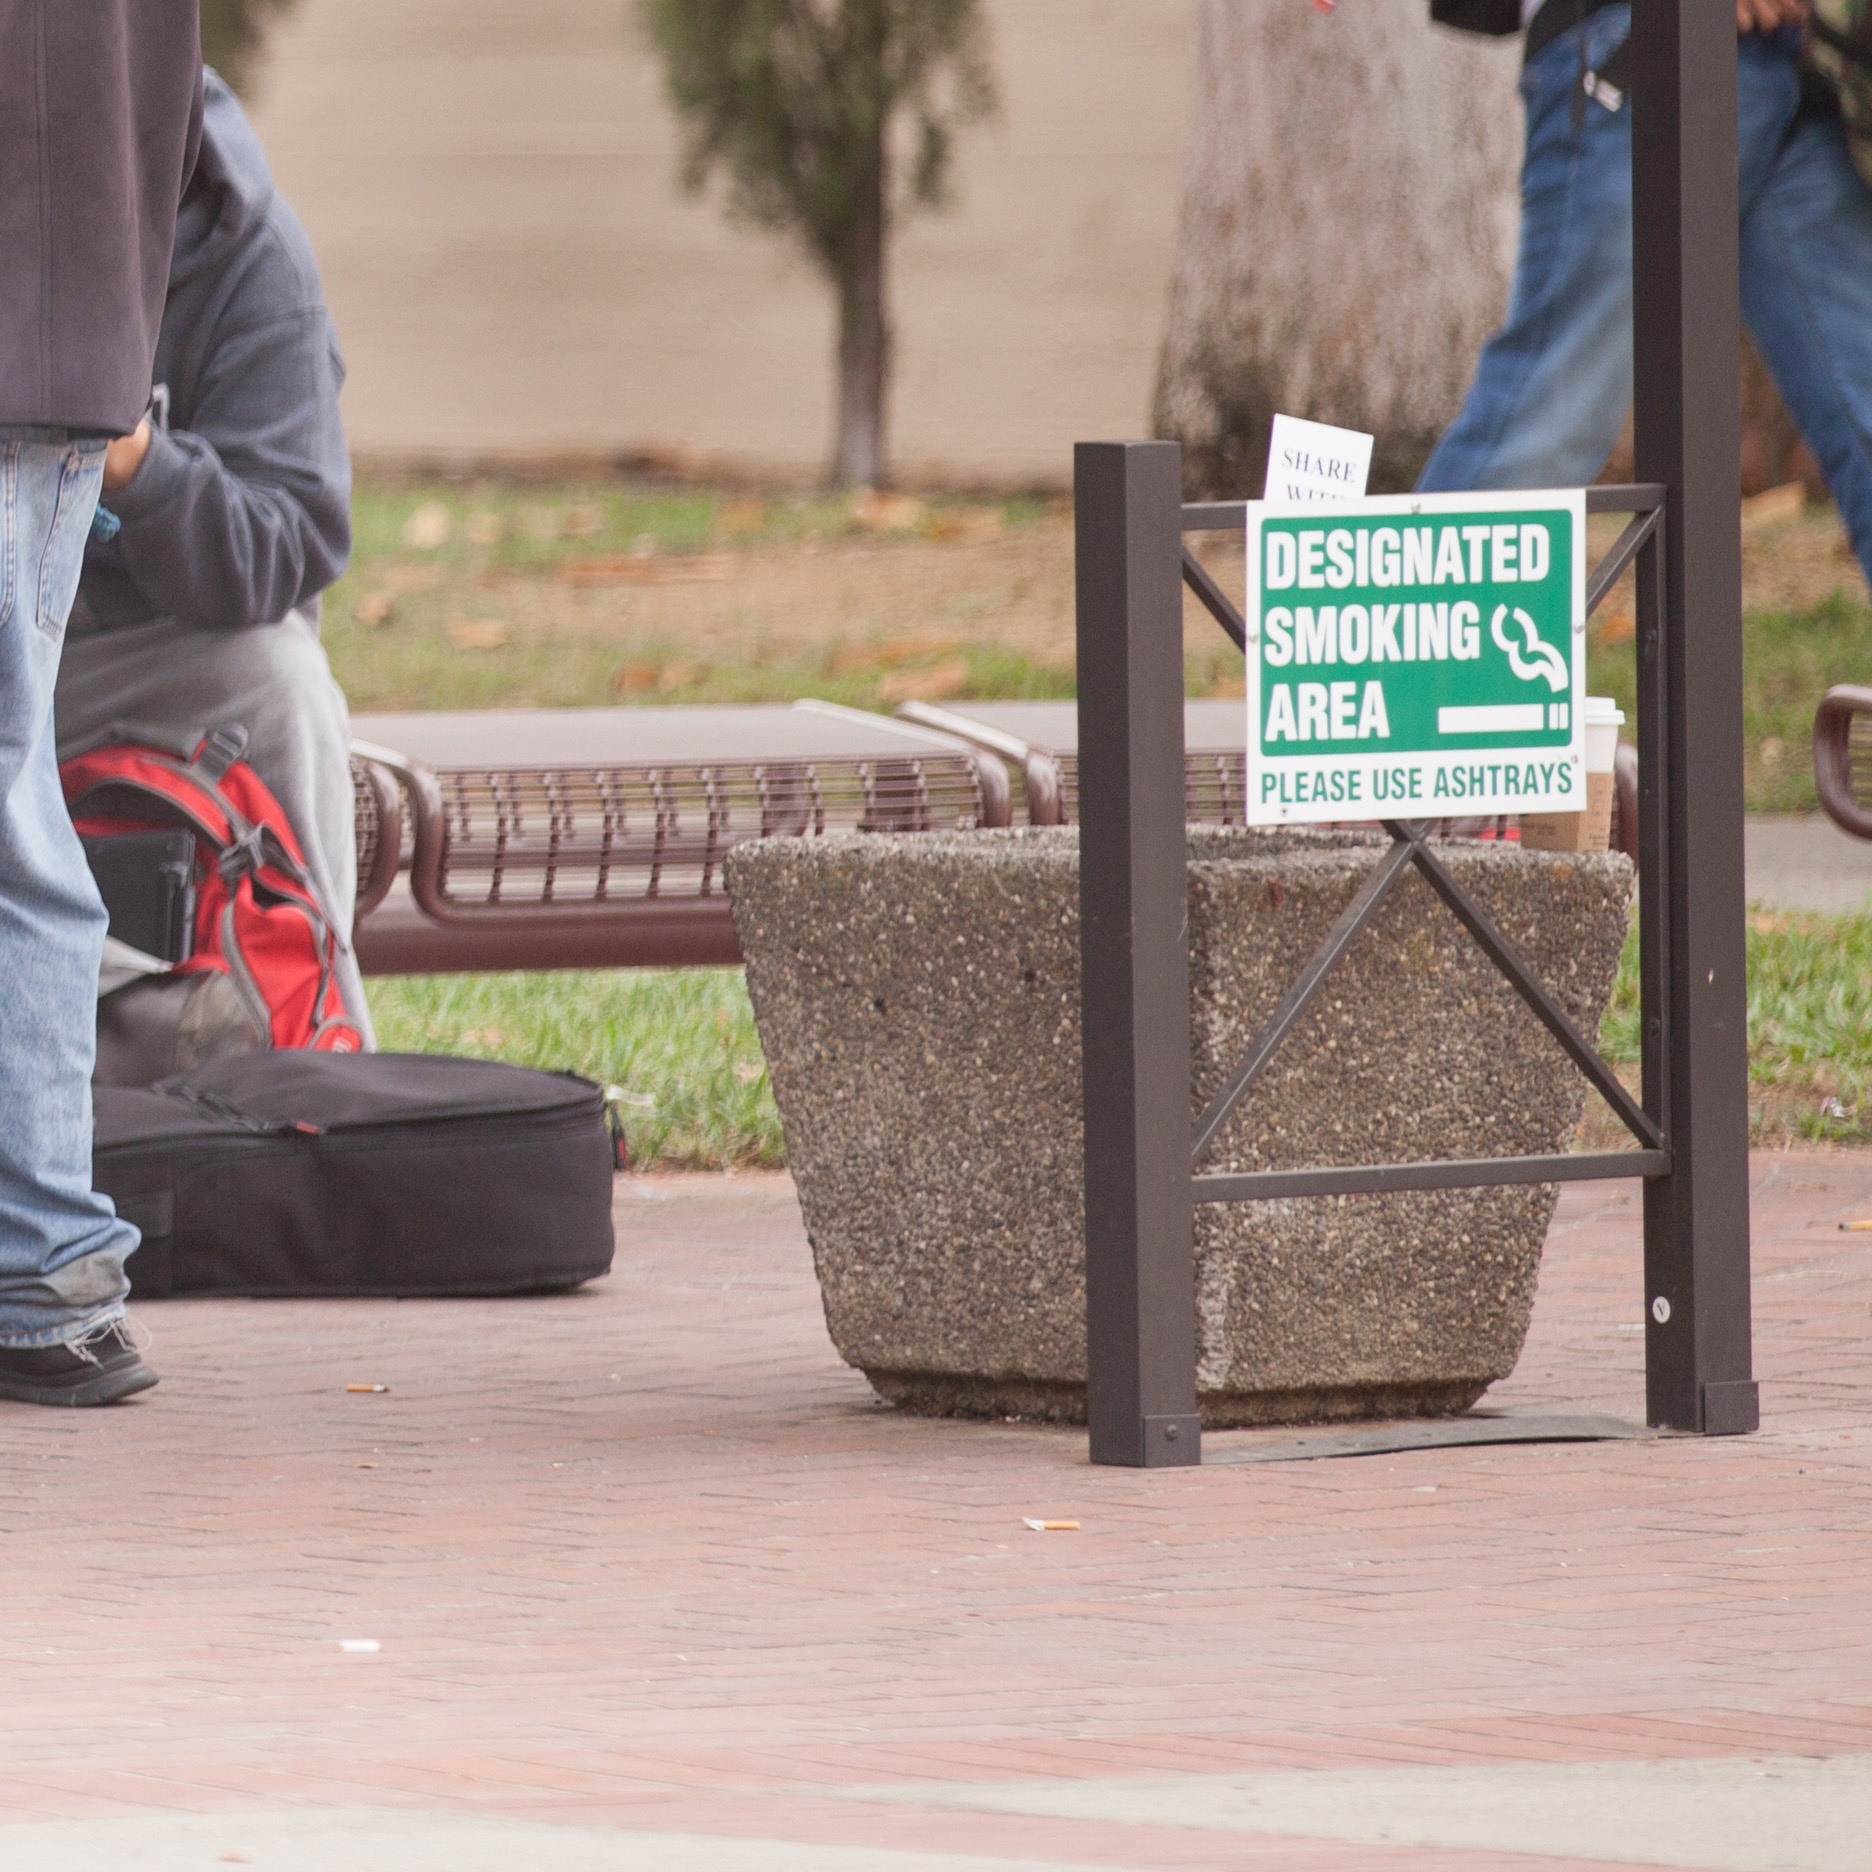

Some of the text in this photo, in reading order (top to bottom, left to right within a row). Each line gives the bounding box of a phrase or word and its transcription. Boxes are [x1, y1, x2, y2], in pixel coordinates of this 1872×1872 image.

[1282, 448, 1356, 483] SHARE
[1265, 523, 1551, 589] DESIGNATED
[1264, 600, 1481, 667] SMOKING
[1264, 680, 1390, 742] AREA
[1261, 762, 1572, 805] PLEASE USE ASHTRAYS
